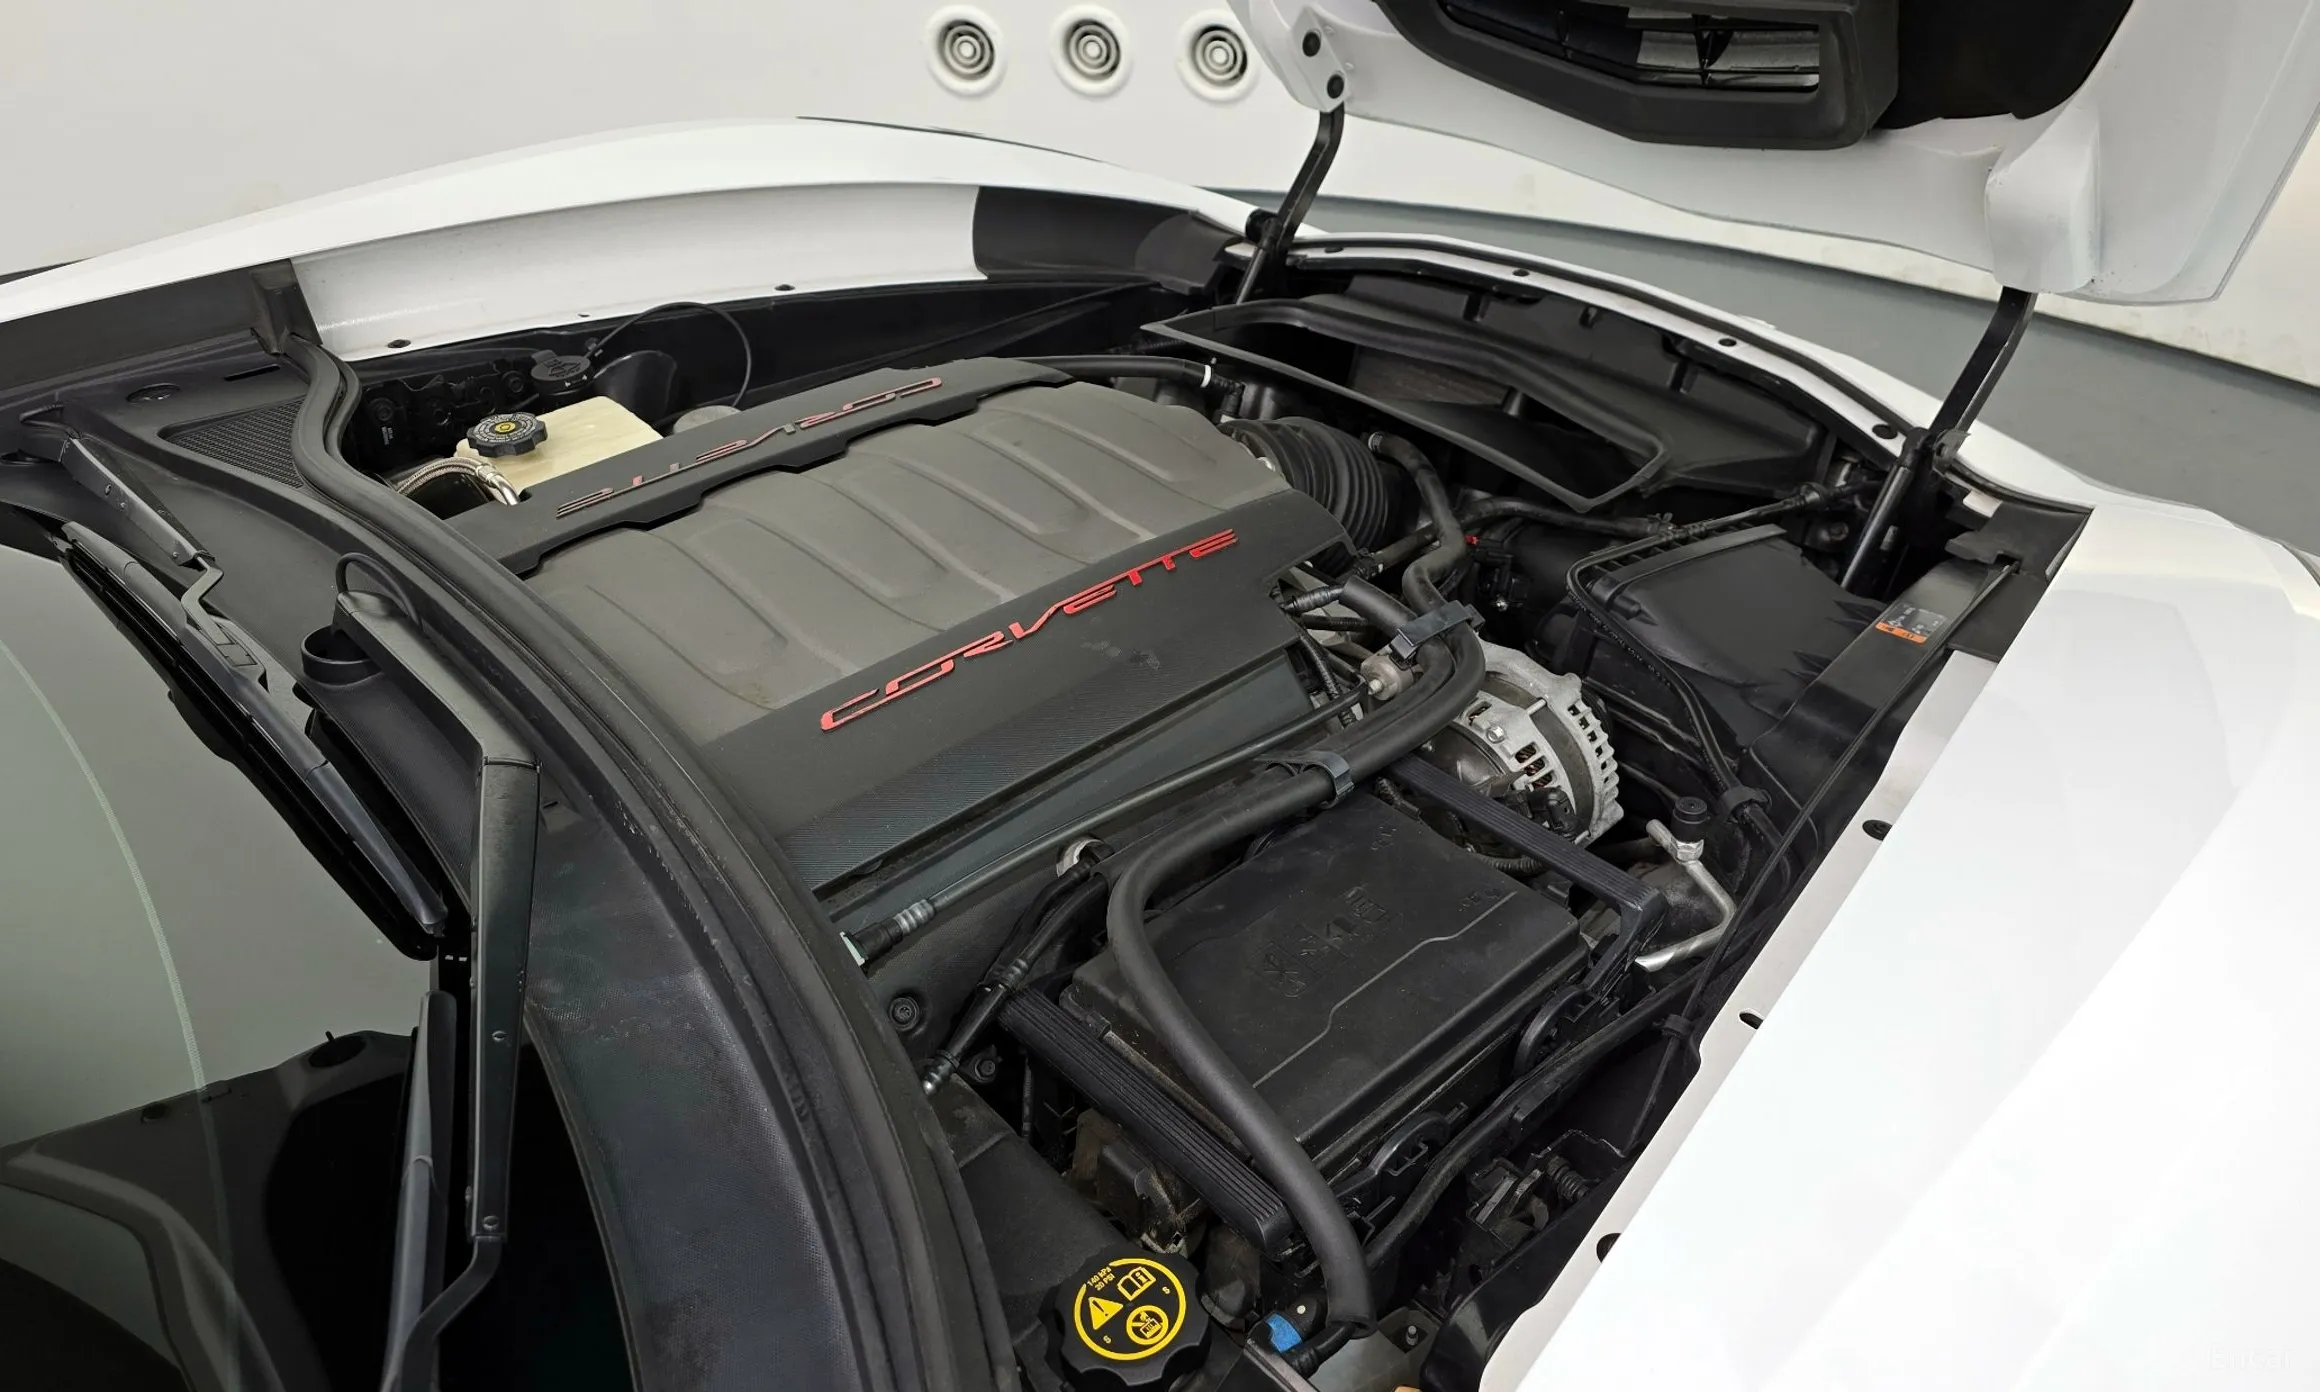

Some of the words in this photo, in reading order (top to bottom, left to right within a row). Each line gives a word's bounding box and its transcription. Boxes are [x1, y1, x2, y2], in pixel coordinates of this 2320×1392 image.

[556, 377, 942, 519] CORVETTE
[820, 529, 1238, 732] CORVETTE
[1086, 1274, 1100, 1287] 140
[1098, 1266, 1112, 1279] kPa
[1103, 1273, 1115, 1284] PSI
